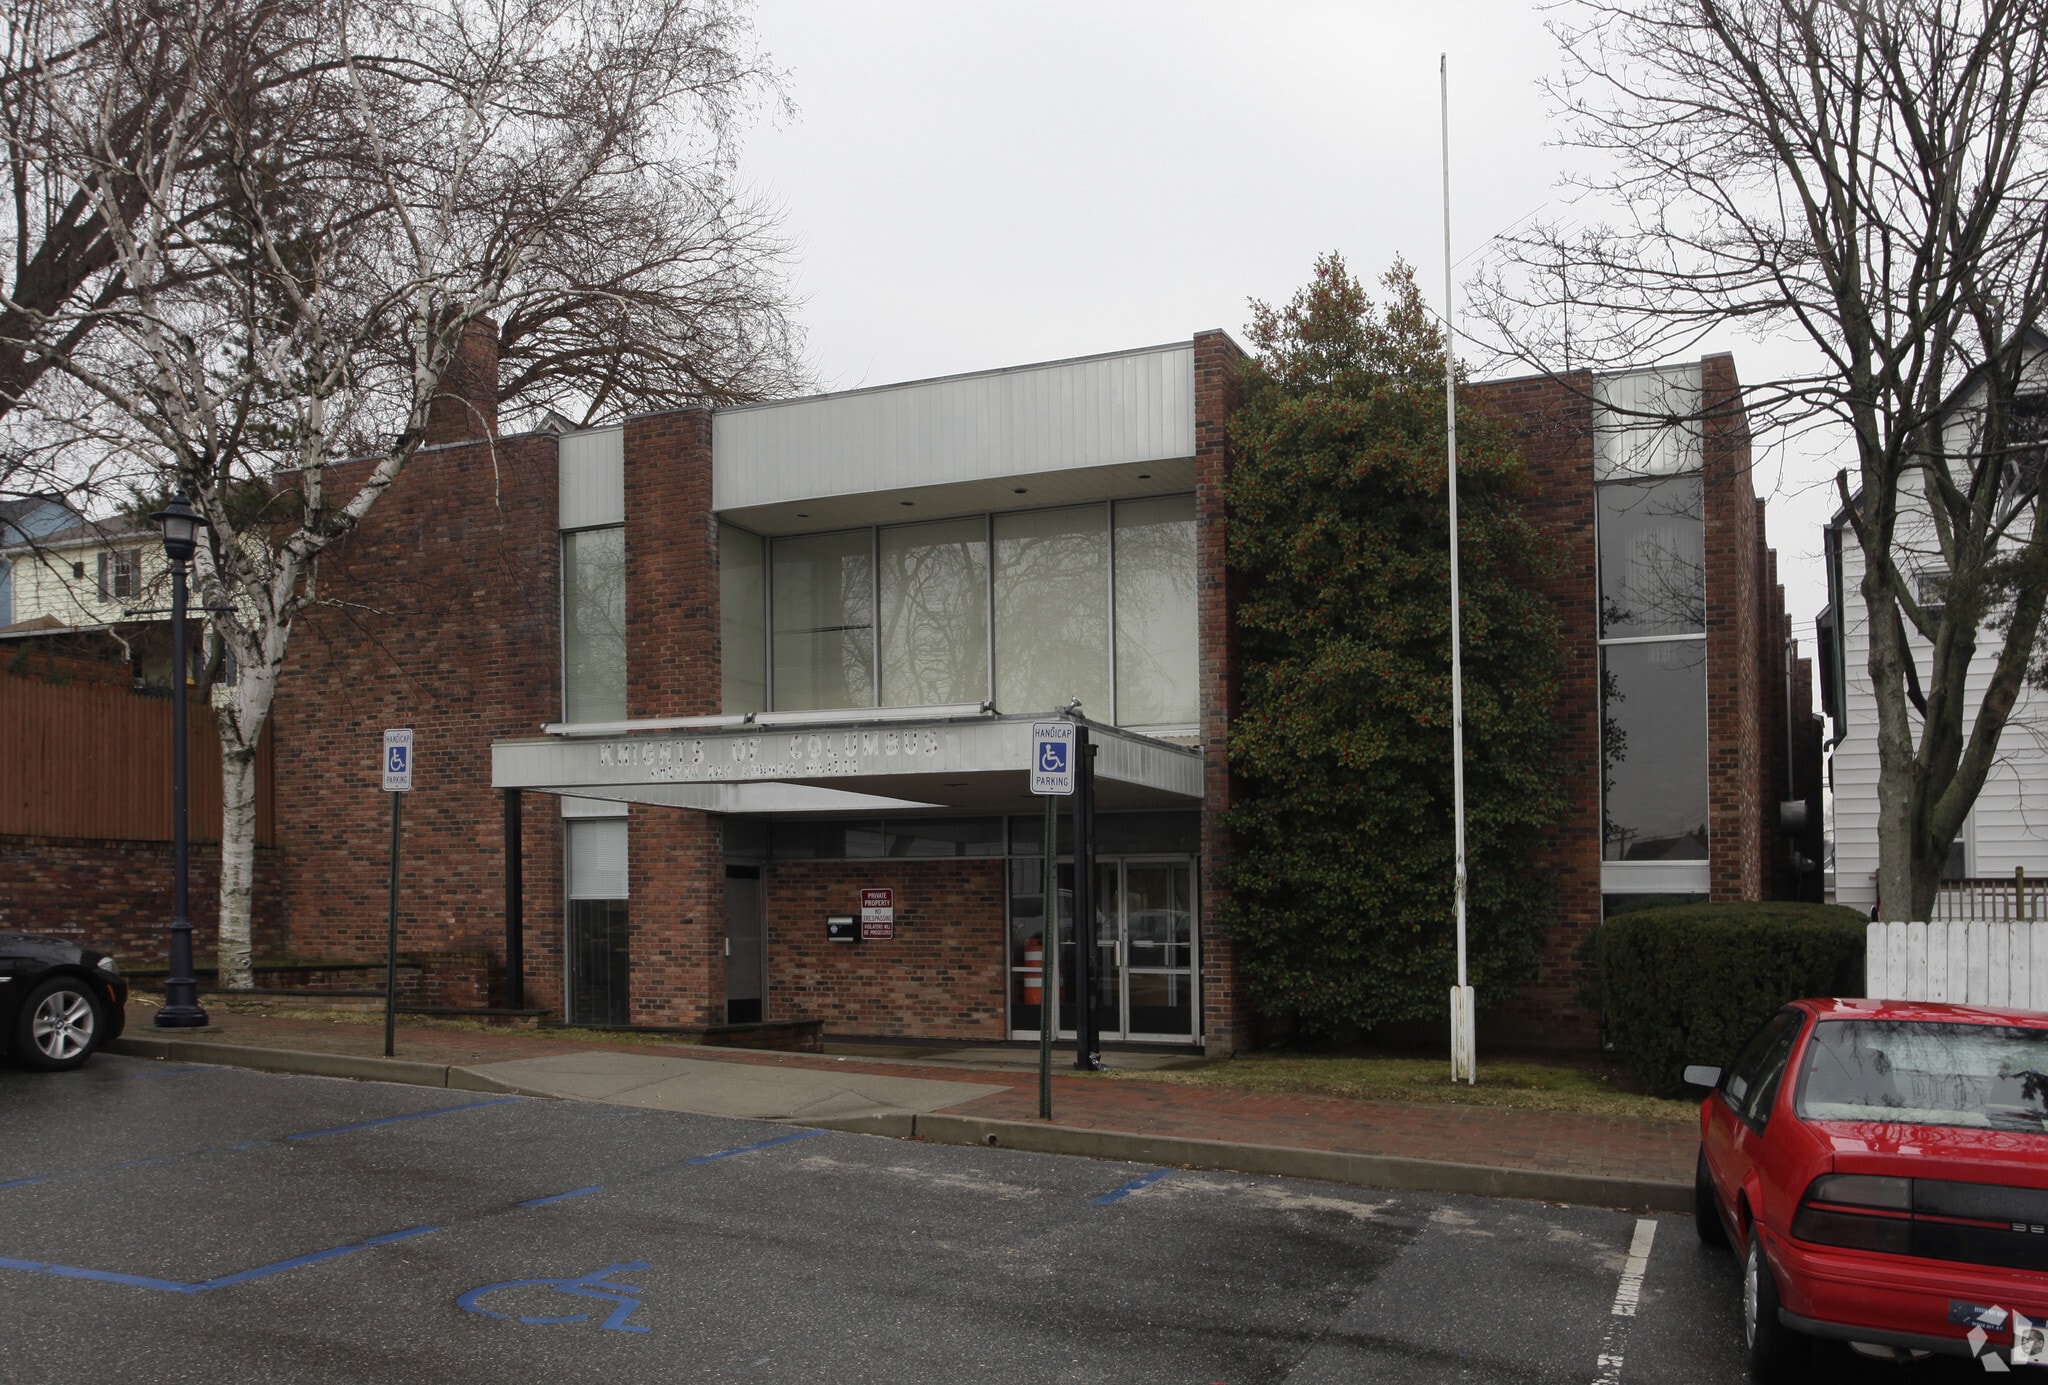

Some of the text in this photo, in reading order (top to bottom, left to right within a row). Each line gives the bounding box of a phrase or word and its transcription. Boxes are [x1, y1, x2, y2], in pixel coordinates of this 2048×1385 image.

[1034, 728, 1072, 738] HANDICAP
[386, 735, 410, 744] HANDICAP
[601, 730, 939, 767] KNIGHTS OF COLUMBUS
[1036, 776, 1068, 786] PARKING
